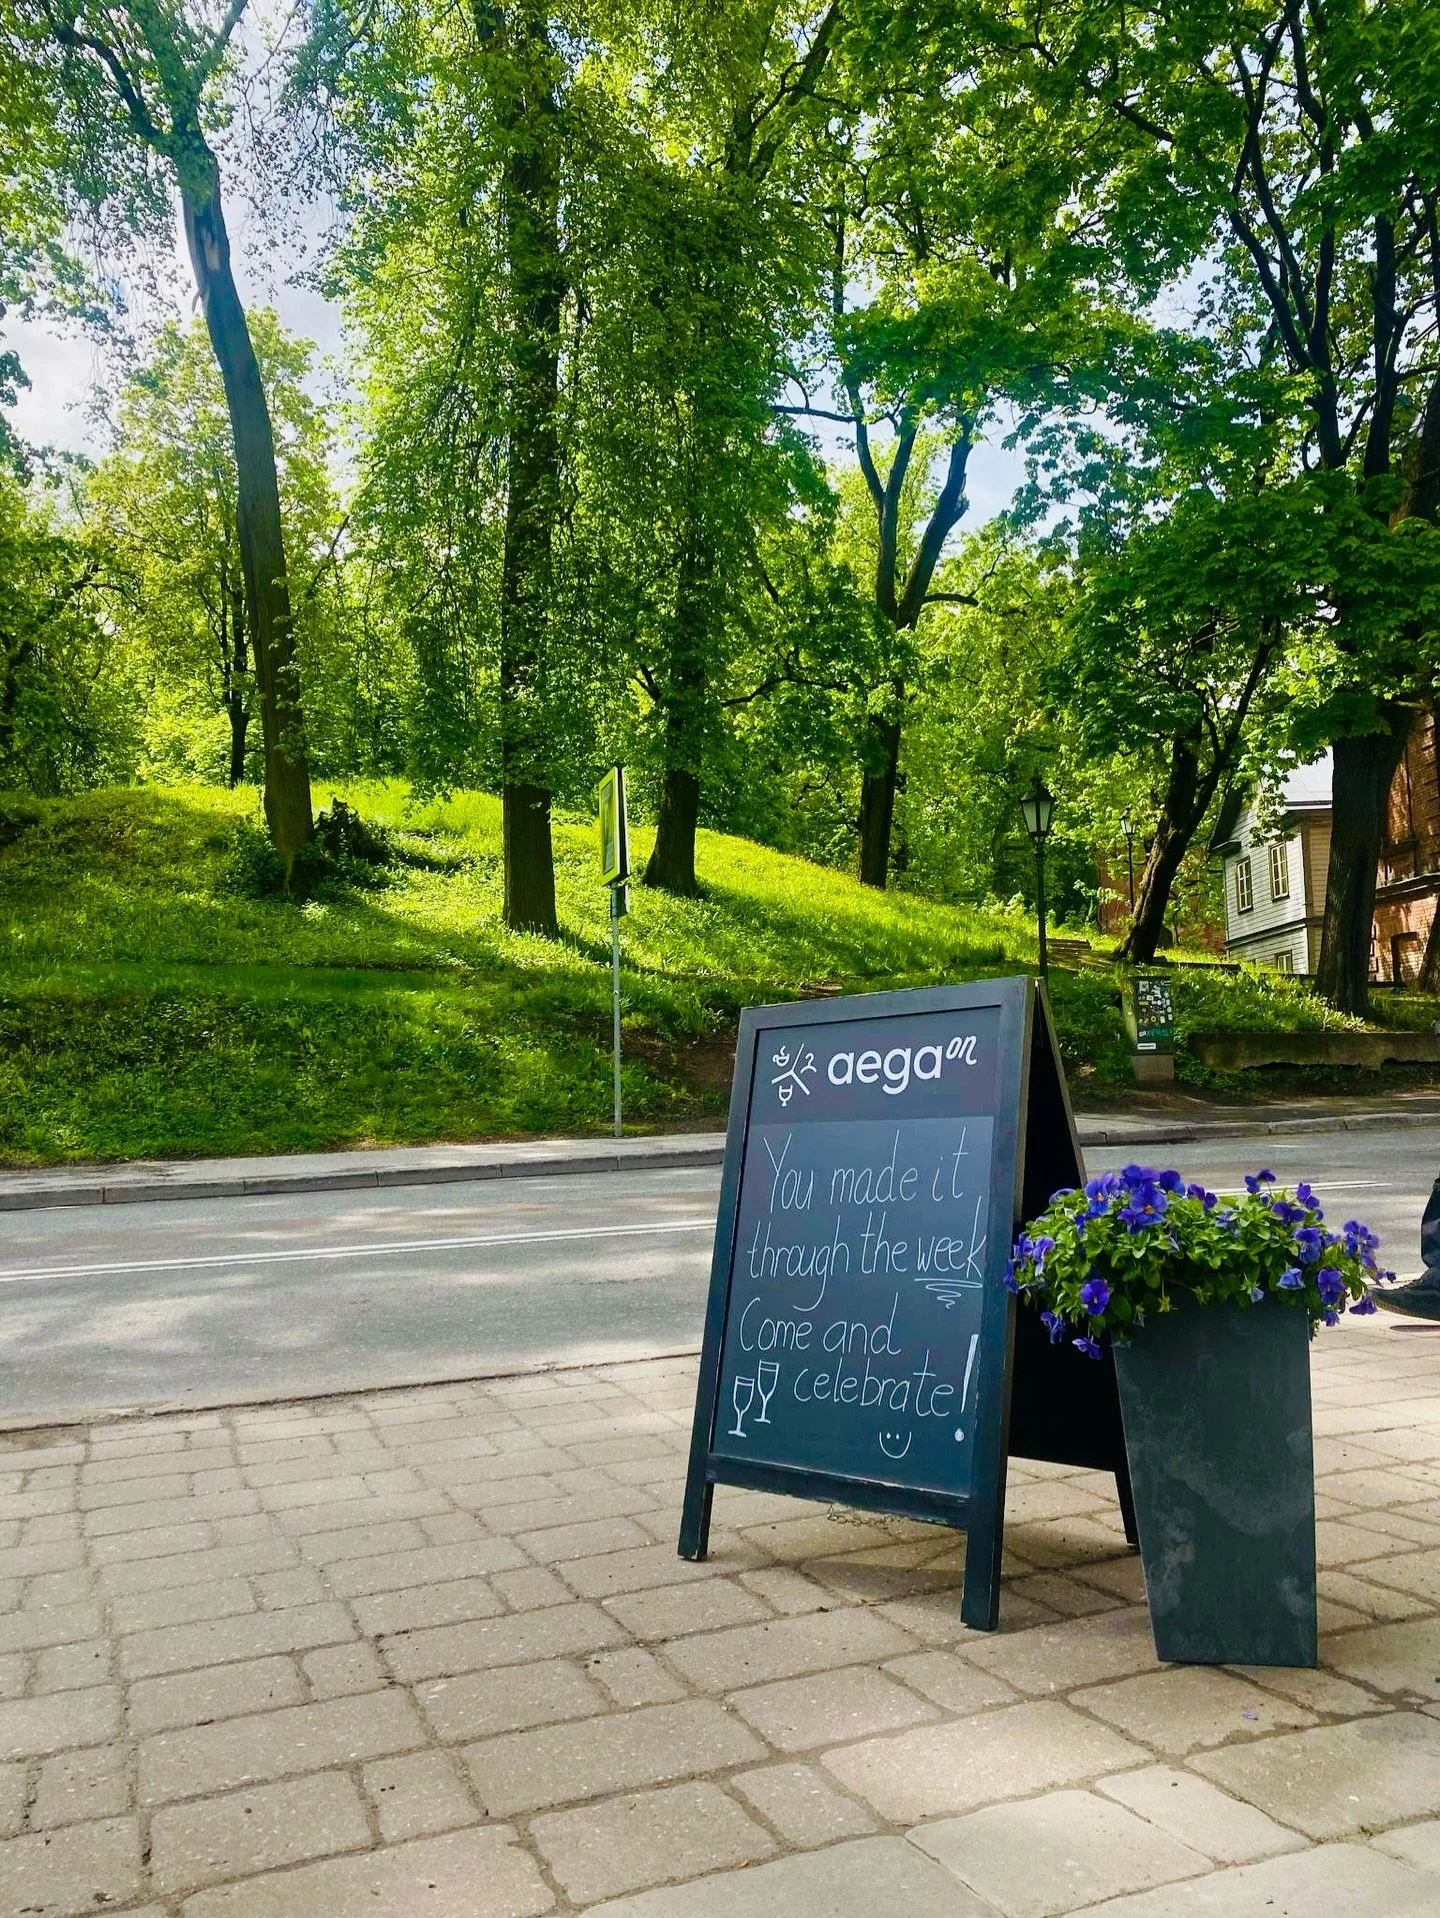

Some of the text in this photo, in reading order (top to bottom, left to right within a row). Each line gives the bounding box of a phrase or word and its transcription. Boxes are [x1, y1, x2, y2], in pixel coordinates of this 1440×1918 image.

[763, 1126, 969, 1212] You made it
[746, 1196, 987, 1311] through the week
[739, 1292, 901, 1356] Come and
[793, 1333, 980, 1442] celebrate!
